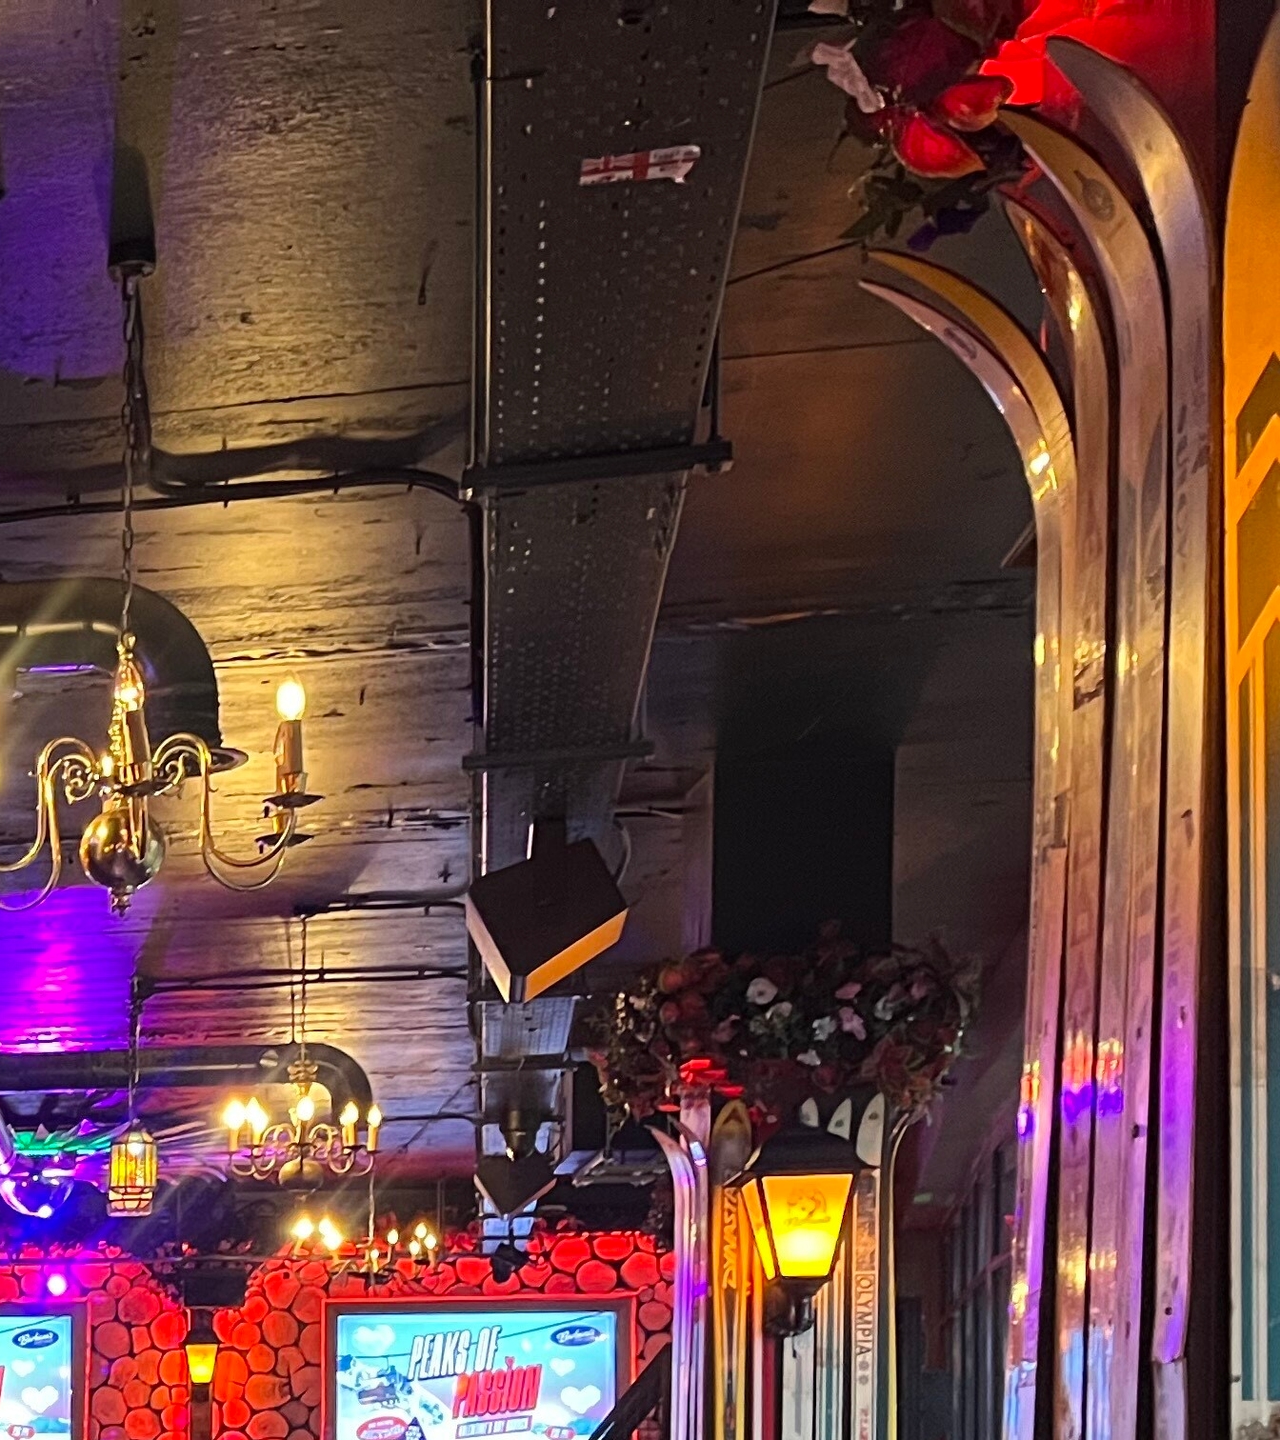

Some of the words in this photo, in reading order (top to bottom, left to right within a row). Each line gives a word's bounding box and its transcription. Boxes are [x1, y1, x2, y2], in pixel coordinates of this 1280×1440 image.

[855, 1277, 874, 1356] OLYMPIA
[408, 1329, 471, 1381] PEAKS
[473, 1325, 503, 1372] OF
[451, 1359, 543, 1419] PASSION
